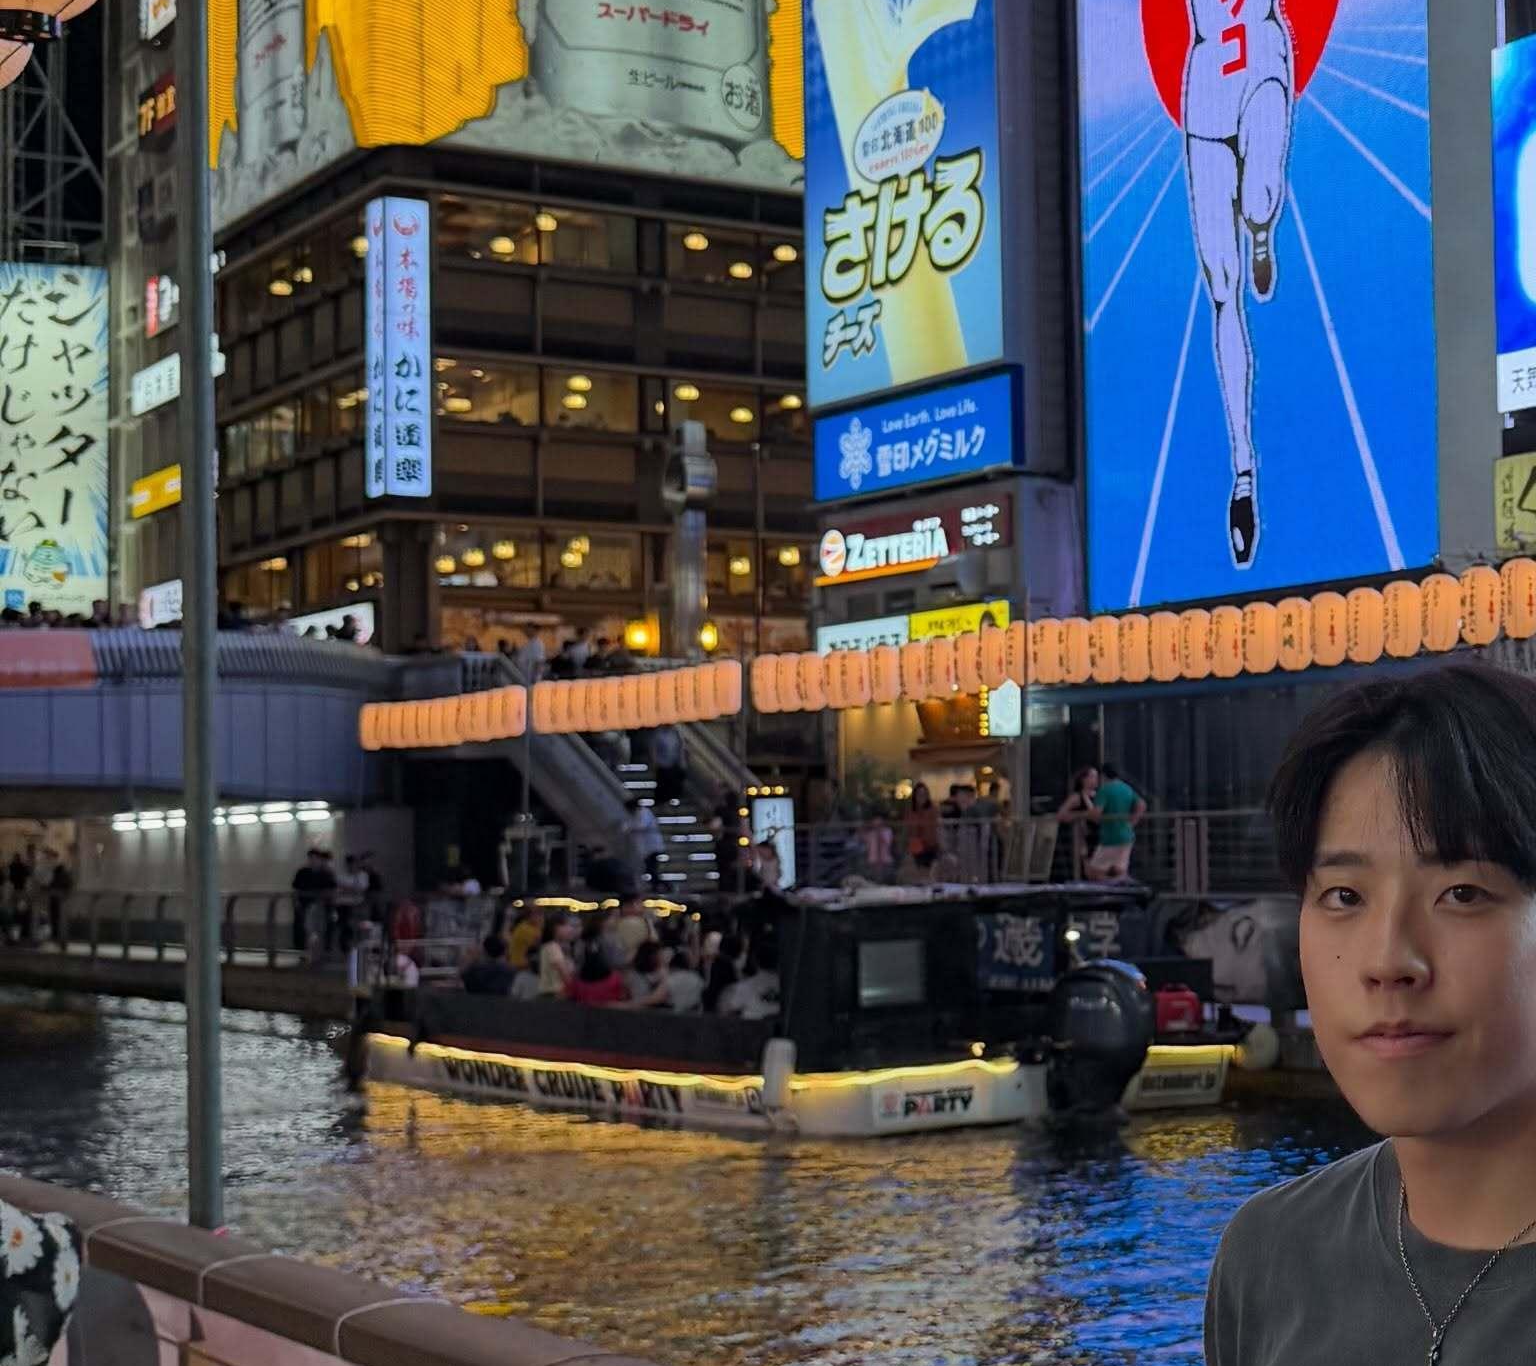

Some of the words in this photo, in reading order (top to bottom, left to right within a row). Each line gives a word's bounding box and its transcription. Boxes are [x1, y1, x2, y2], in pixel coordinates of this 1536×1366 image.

[596, 2, 710, 39] スーパードライ
[822, 146, 987, 305] さける
[822, 299, 883, 370] チーズ
[45, 271, 103, 527] シャッター
[875, 424, 986, 478] 雪印メグミルク
[845, 528, 949, 572] ZETTERIA
[903, 1095, 975, 1117] PARTY
